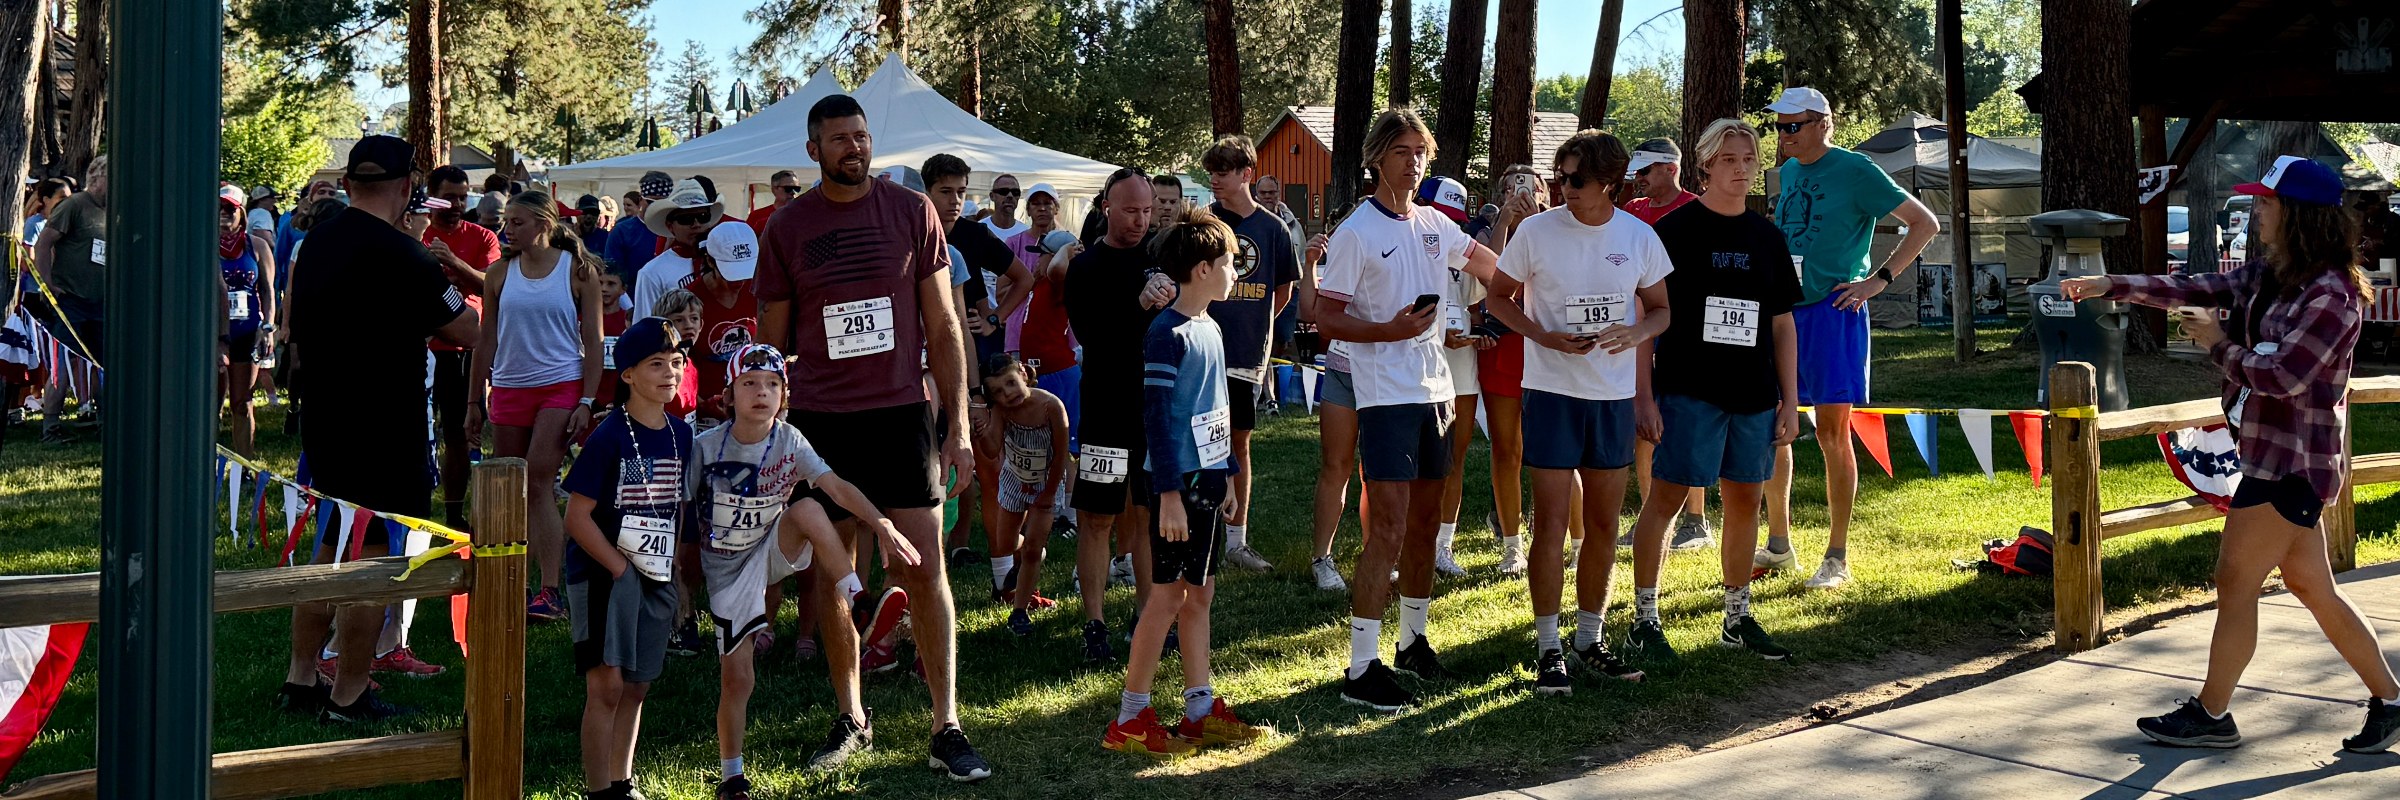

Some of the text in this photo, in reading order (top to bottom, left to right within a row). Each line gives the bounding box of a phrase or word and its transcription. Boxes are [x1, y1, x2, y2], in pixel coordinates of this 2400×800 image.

[1794, 214, 1823, 248] CLUB
[1584, 306, 1610, 322] 193
[1721, 310, 1745, 327] 194
[843, 313, 875, 335] 293
[1207, 422, 1225, 442] 295
[1012, 453, 1032, 470] 139
[1090, 457, 1114, 474] 201
[731, 509, 763, 528] 241
[637, 533, 667, 555] 240
